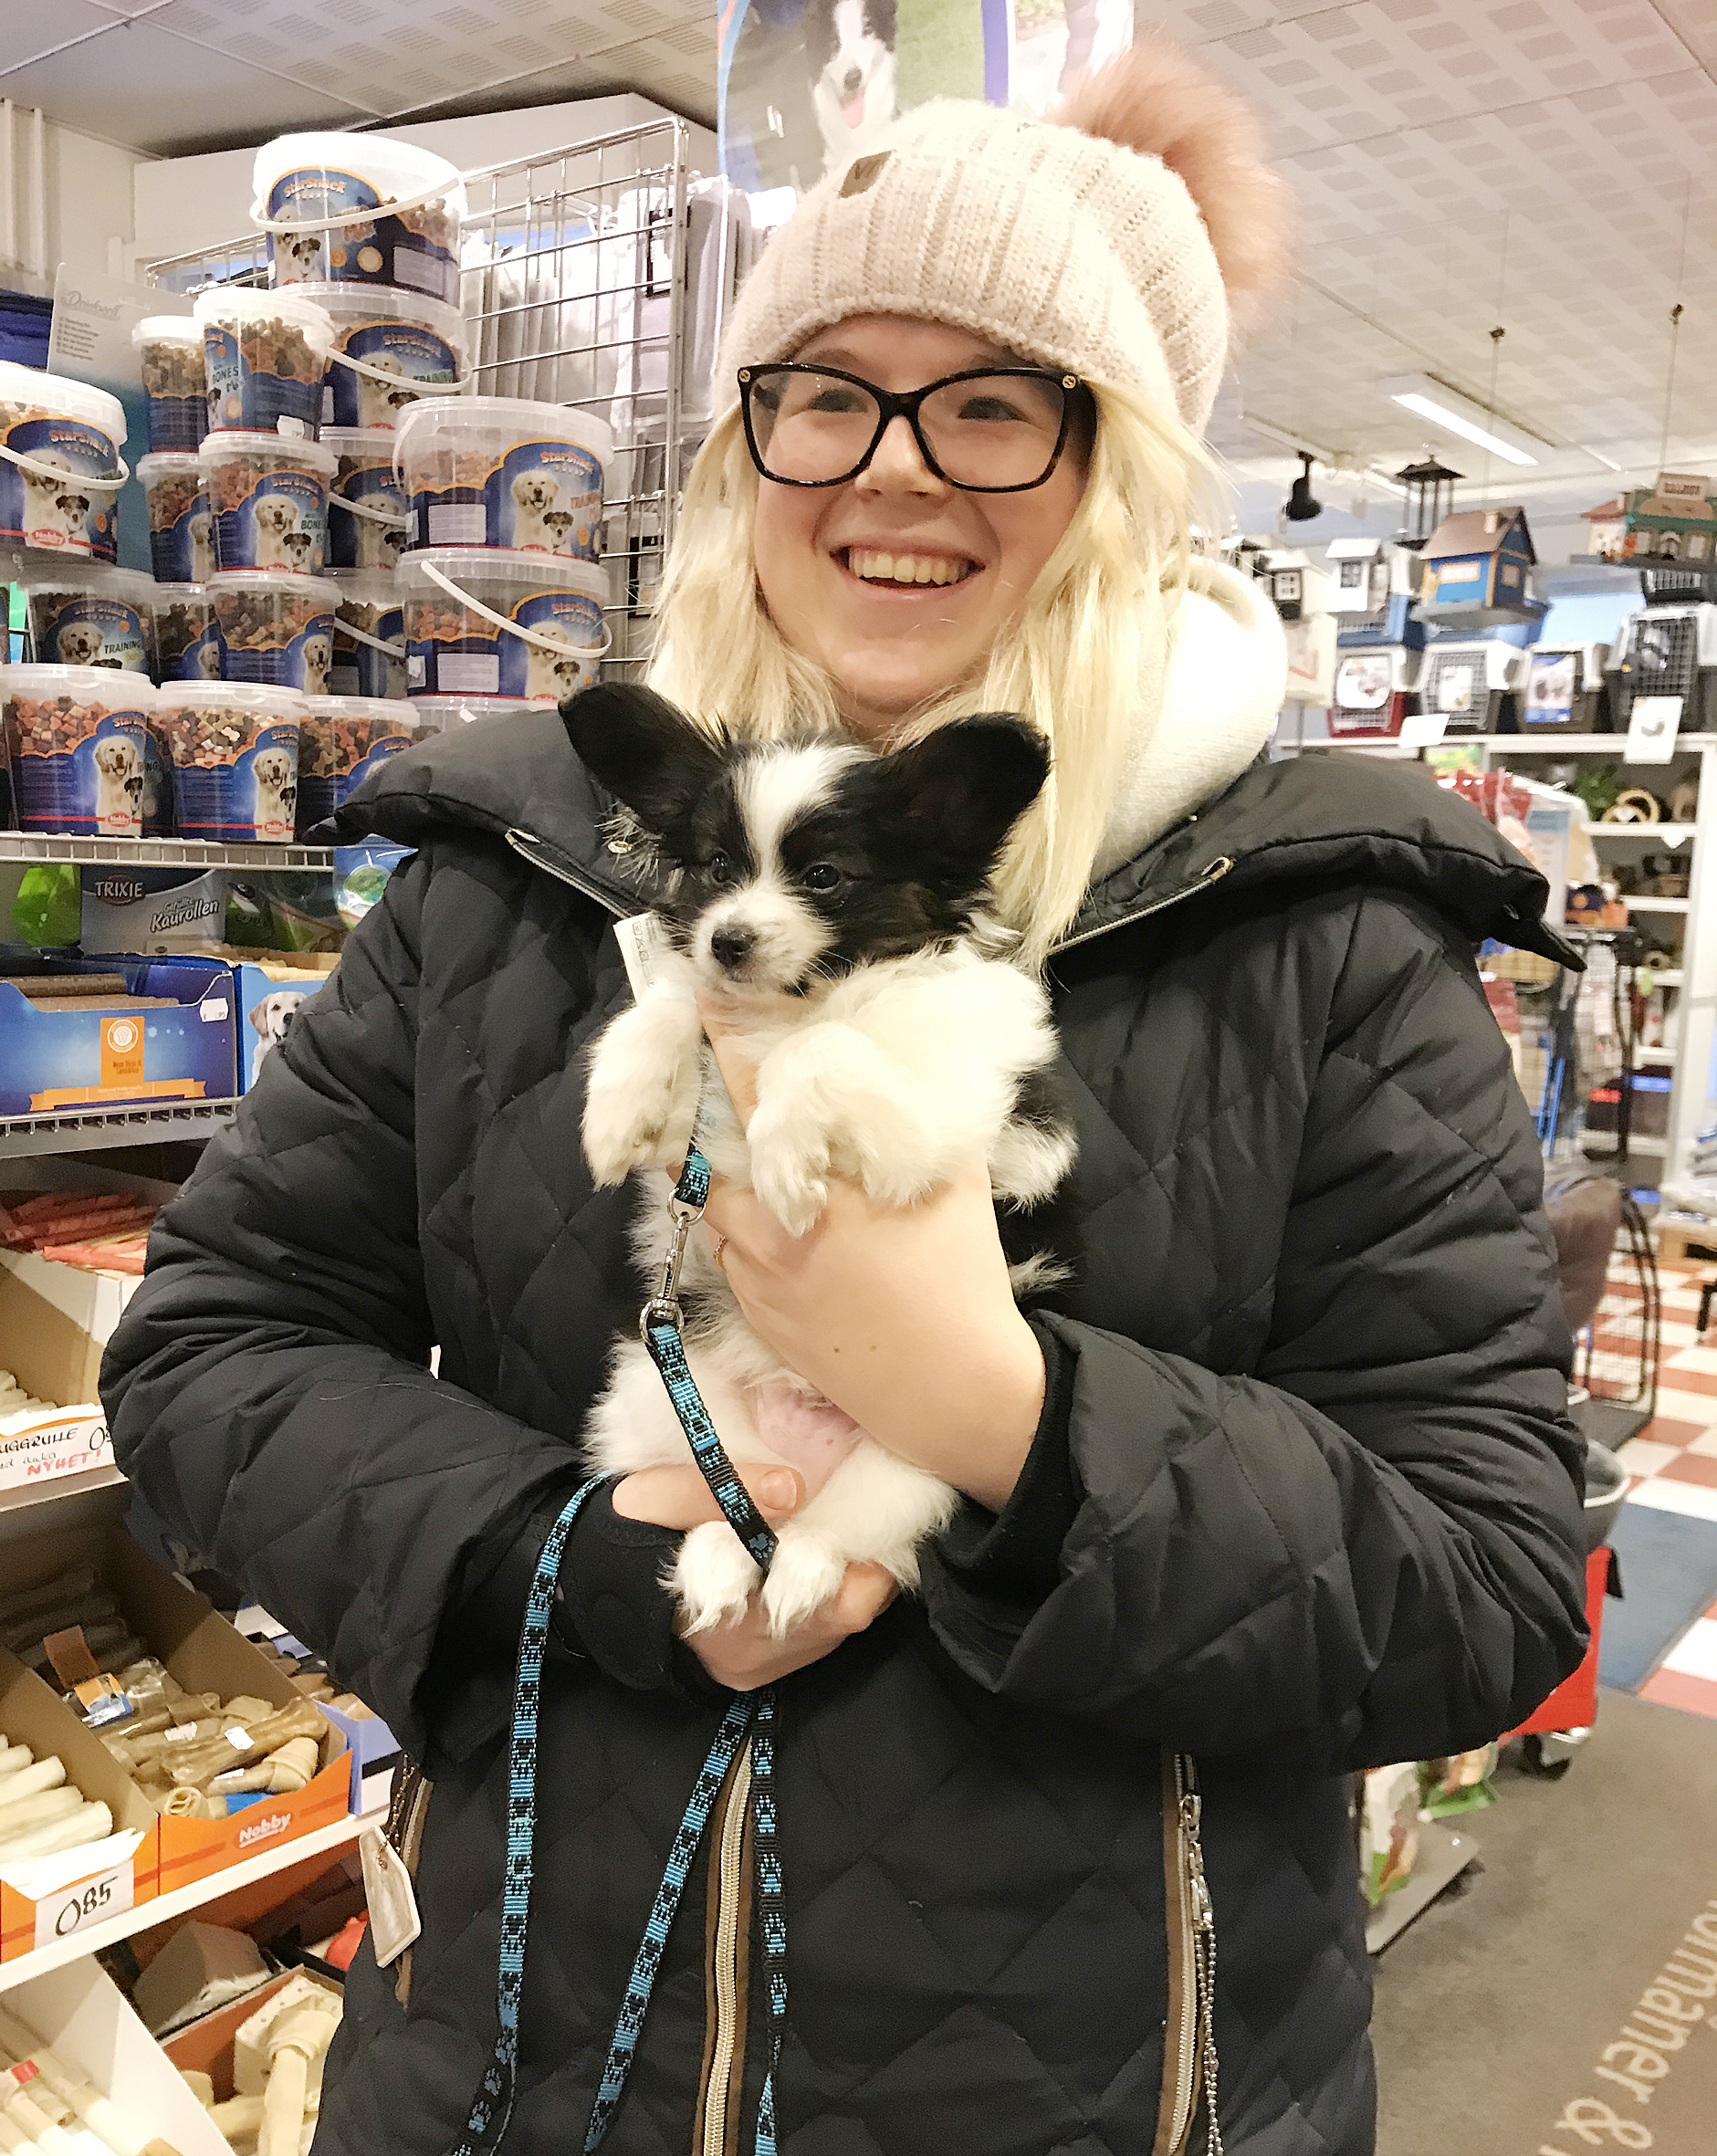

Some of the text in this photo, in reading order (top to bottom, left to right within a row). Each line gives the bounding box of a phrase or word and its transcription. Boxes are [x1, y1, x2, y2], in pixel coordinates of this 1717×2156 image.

[104, 640, 142, 655] TRAINING
[94, 881, 144, 898] TRIXIE
[151, 899, 219, 933] Kaurollen
[27, 1449, 101, 1476] NYHET!
[239, 1813, 291, 1845] Nobby
[1555, 2096, 1653, 2151] &
